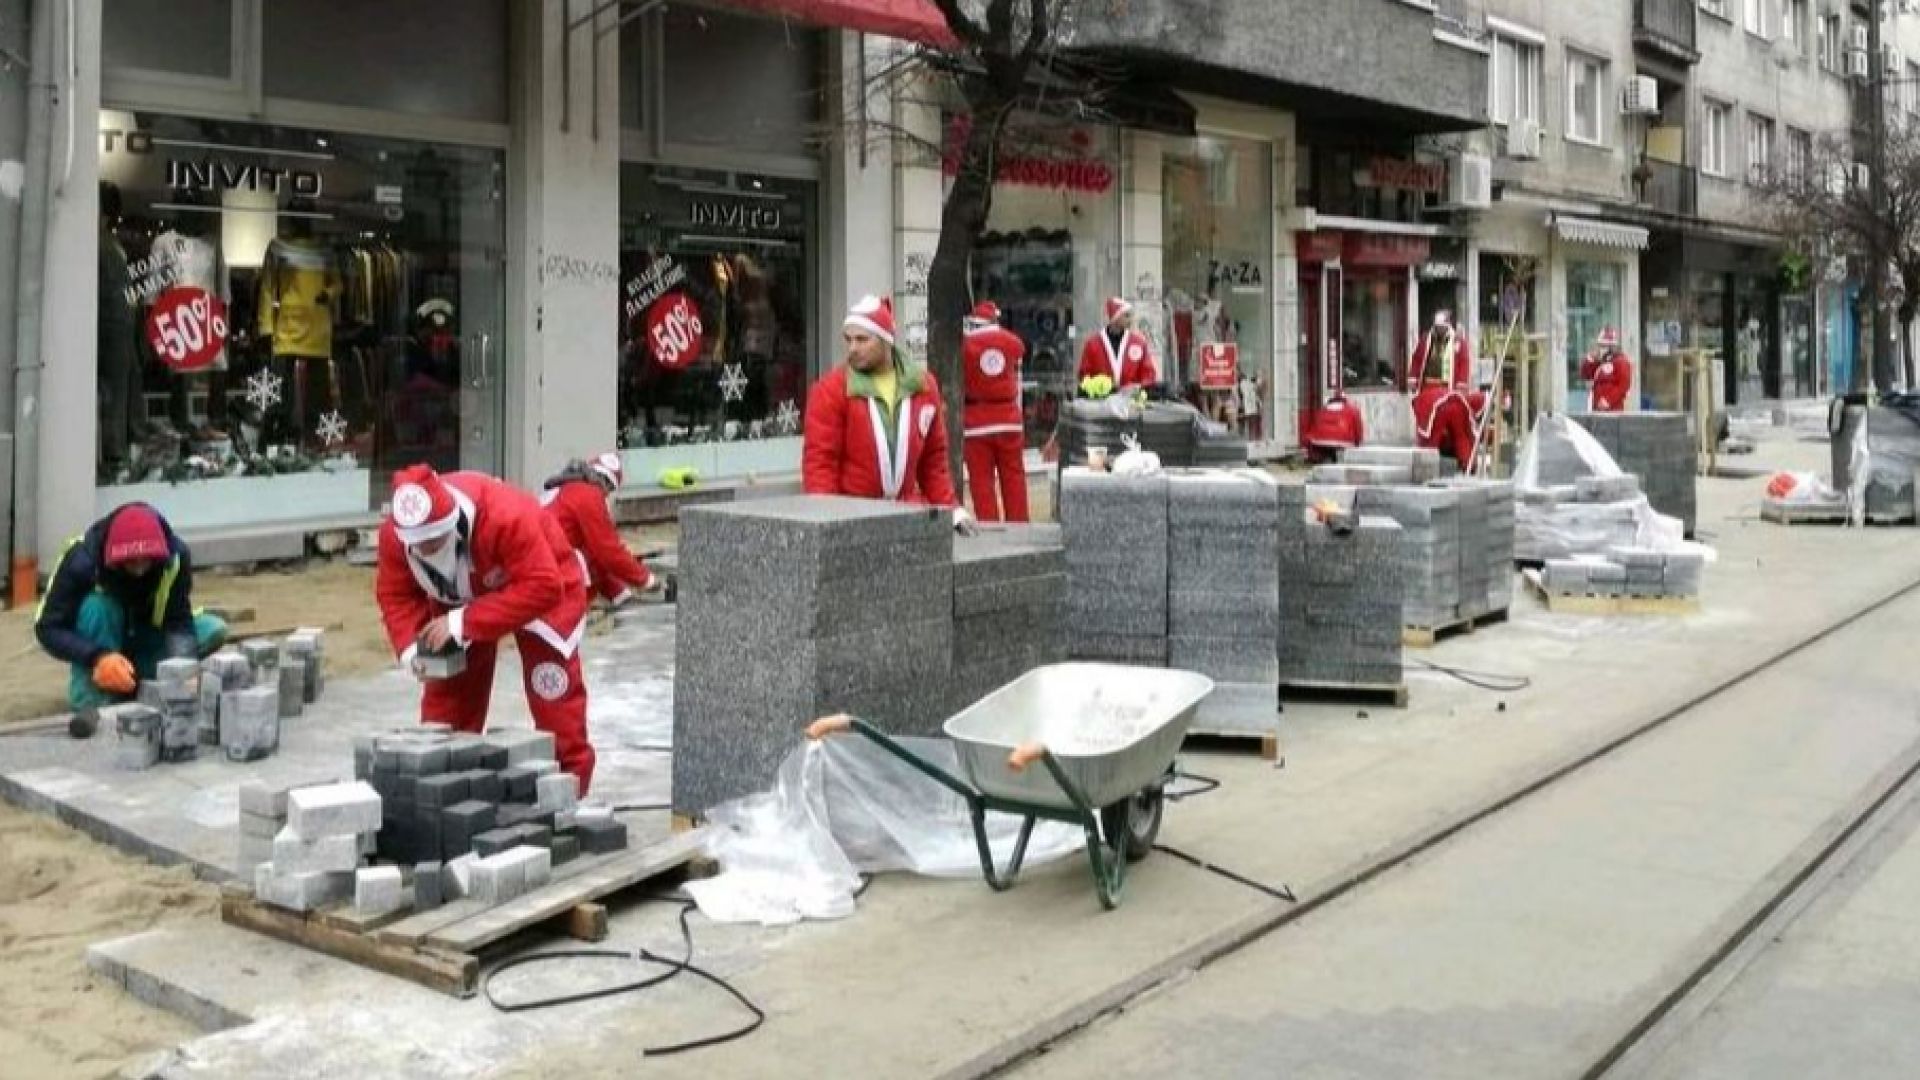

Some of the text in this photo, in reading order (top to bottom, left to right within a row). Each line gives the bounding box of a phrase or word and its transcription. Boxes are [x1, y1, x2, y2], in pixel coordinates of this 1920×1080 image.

[166, 159, 323, 198] INVITO
[690, 202, 780, 230] INVITO
[153, 292, 227, 361] -50%
[652, 293, 703, 363] -50%
